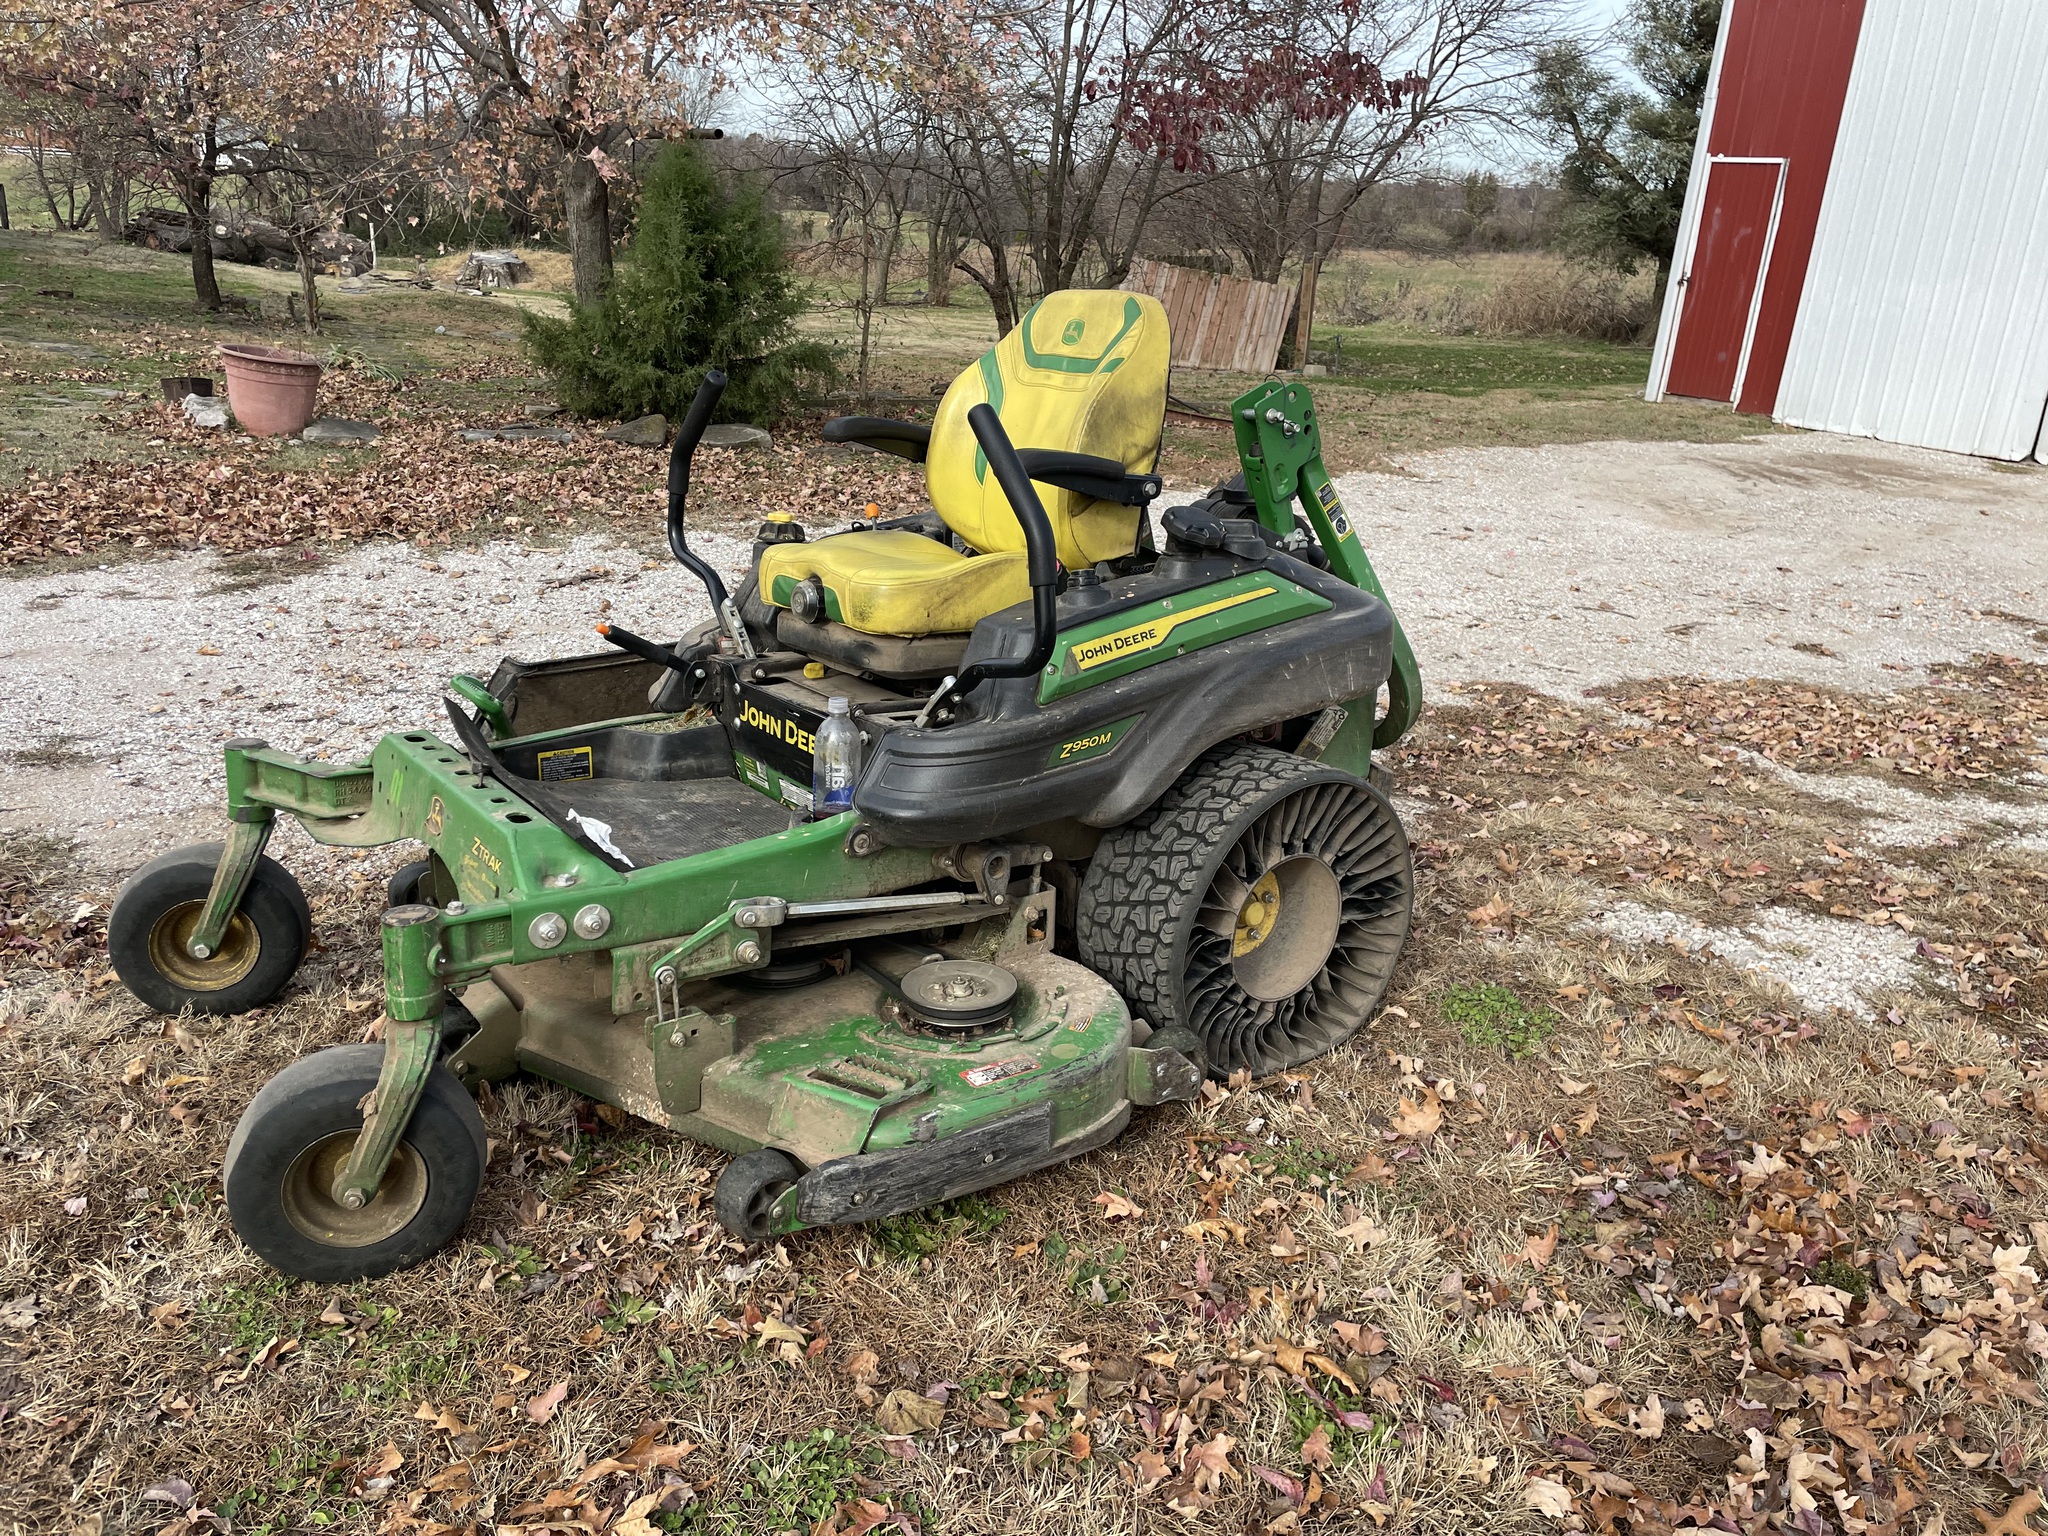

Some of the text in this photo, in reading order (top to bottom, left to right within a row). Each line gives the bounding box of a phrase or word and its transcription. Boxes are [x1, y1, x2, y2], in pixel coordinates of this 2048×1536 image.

[1079, 628, 1157, 662] JOHN DEERE
[740, 700, 816, 755] JOHN DEE
[1060, 732, 1112, 759] Z950M
[471, 836, 503, 875] ZTRAK
